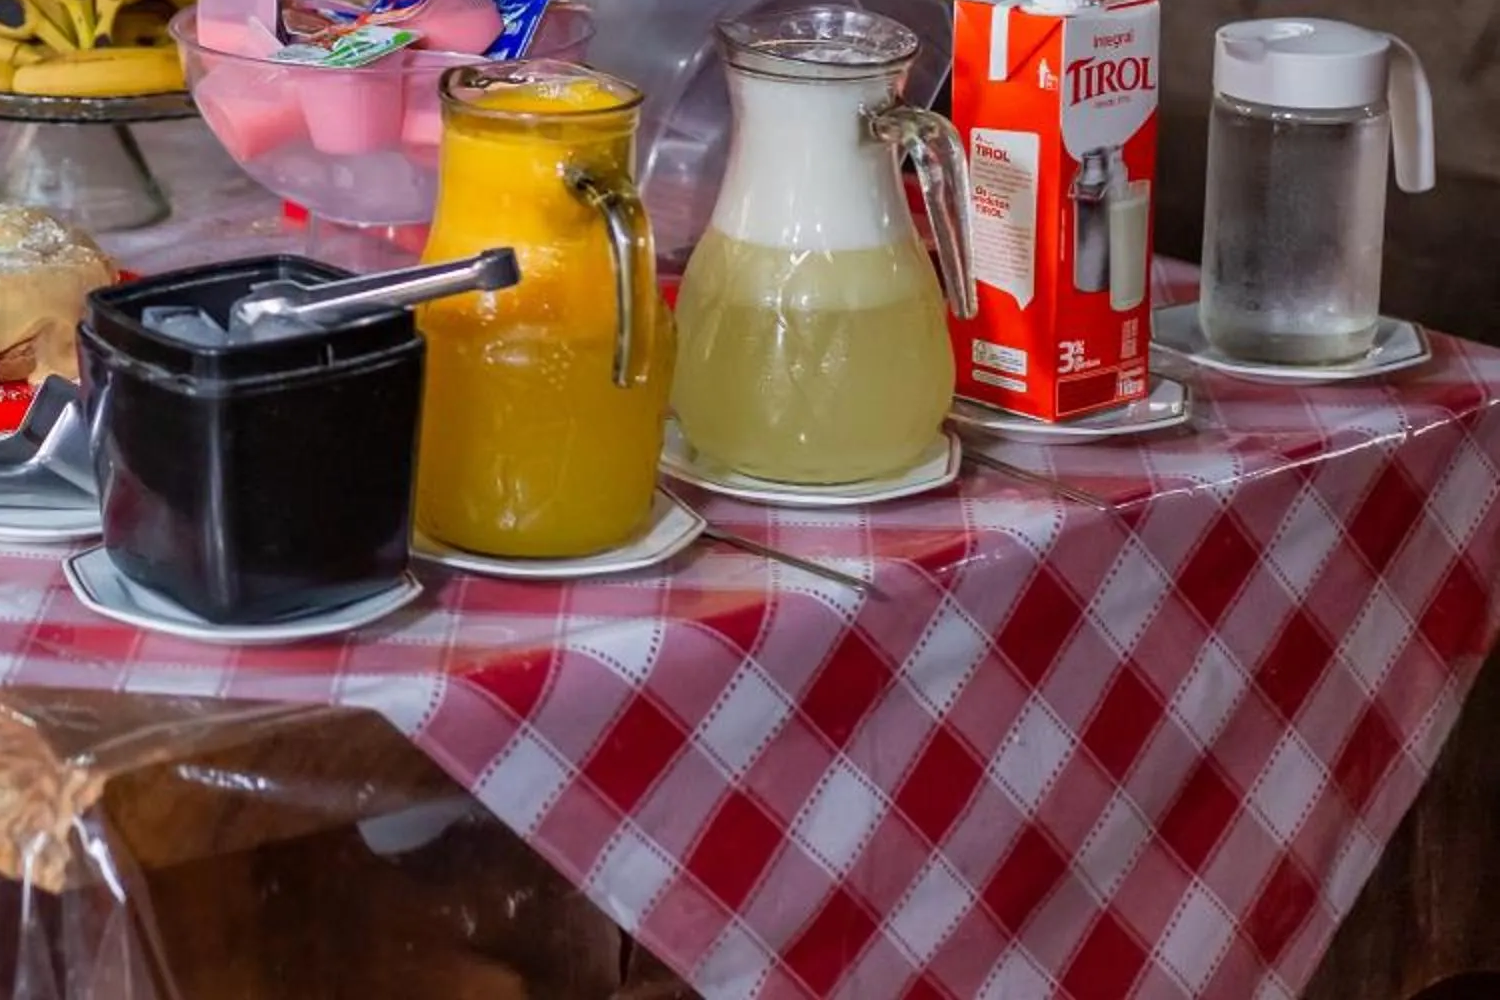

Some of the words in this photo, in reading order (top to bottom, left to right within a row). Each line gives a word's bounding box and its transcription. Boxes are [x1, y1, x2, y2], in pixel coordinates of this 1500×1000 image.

[1092, 31, 1134, 48] Integral
[1066, 56, 1156, 106] TIROL
[975, 144, 1010, 162] TIROL
